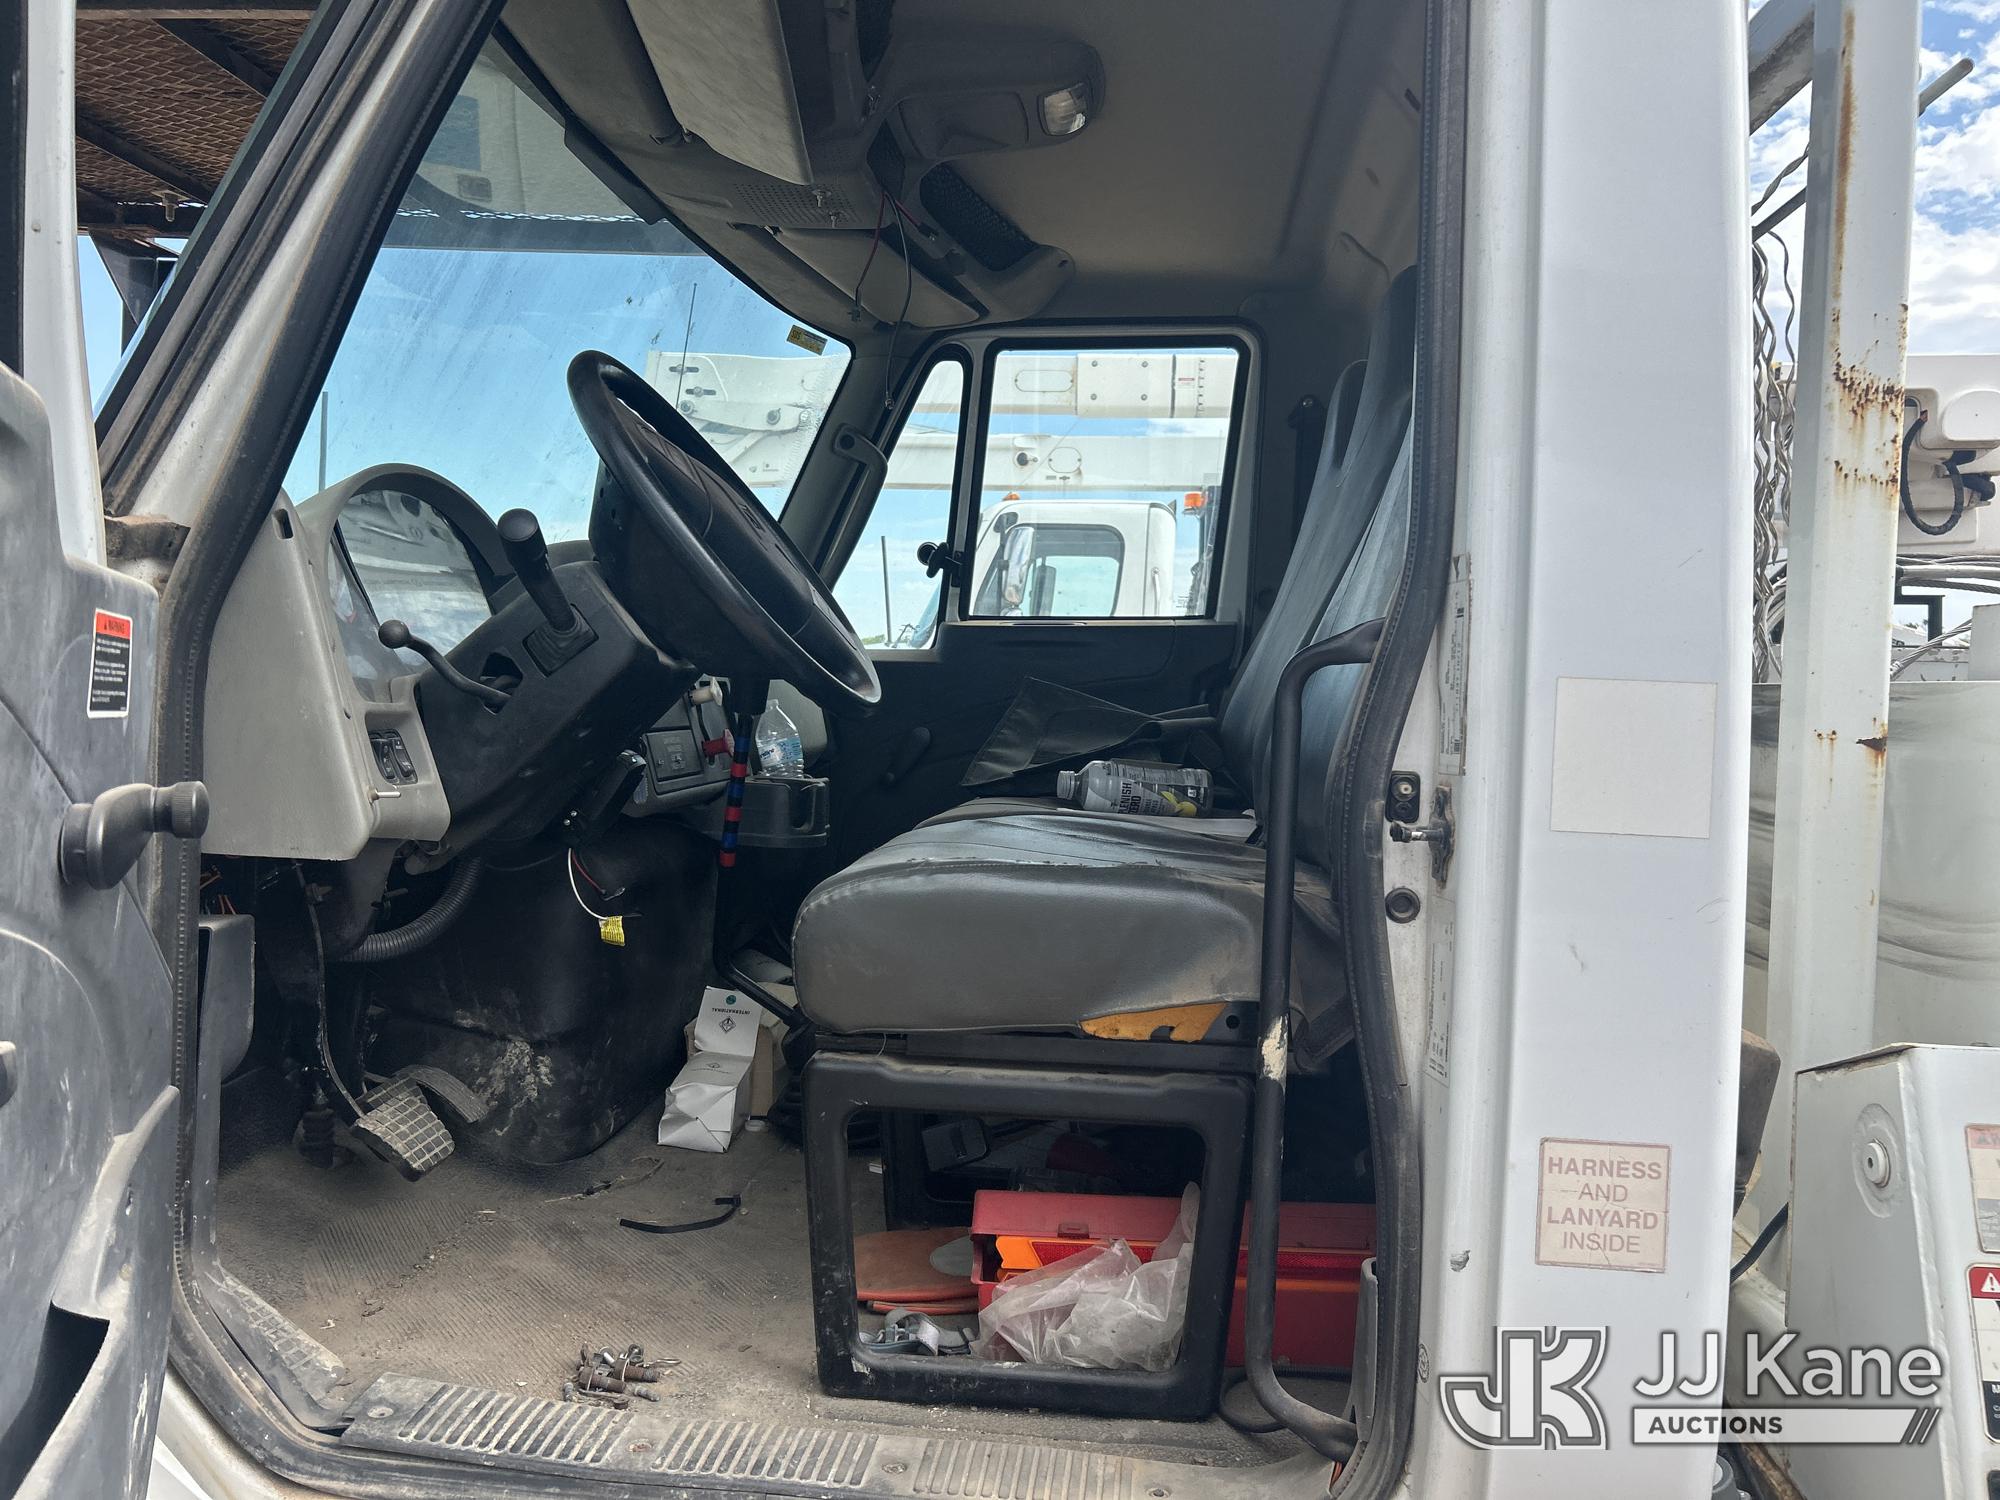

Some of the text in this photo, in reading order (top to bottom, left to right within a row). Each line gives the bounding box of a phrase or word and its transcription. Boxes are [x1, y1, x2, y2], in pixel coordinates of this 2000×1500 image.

[1548, 1156, 1662, 1180] HARNESS
[1578, 1182, 1628, 1202] AND
[1547, 1206, 1658, 1229] LANYARD
[1563, 1231, 1641, 1254] INSIDE
